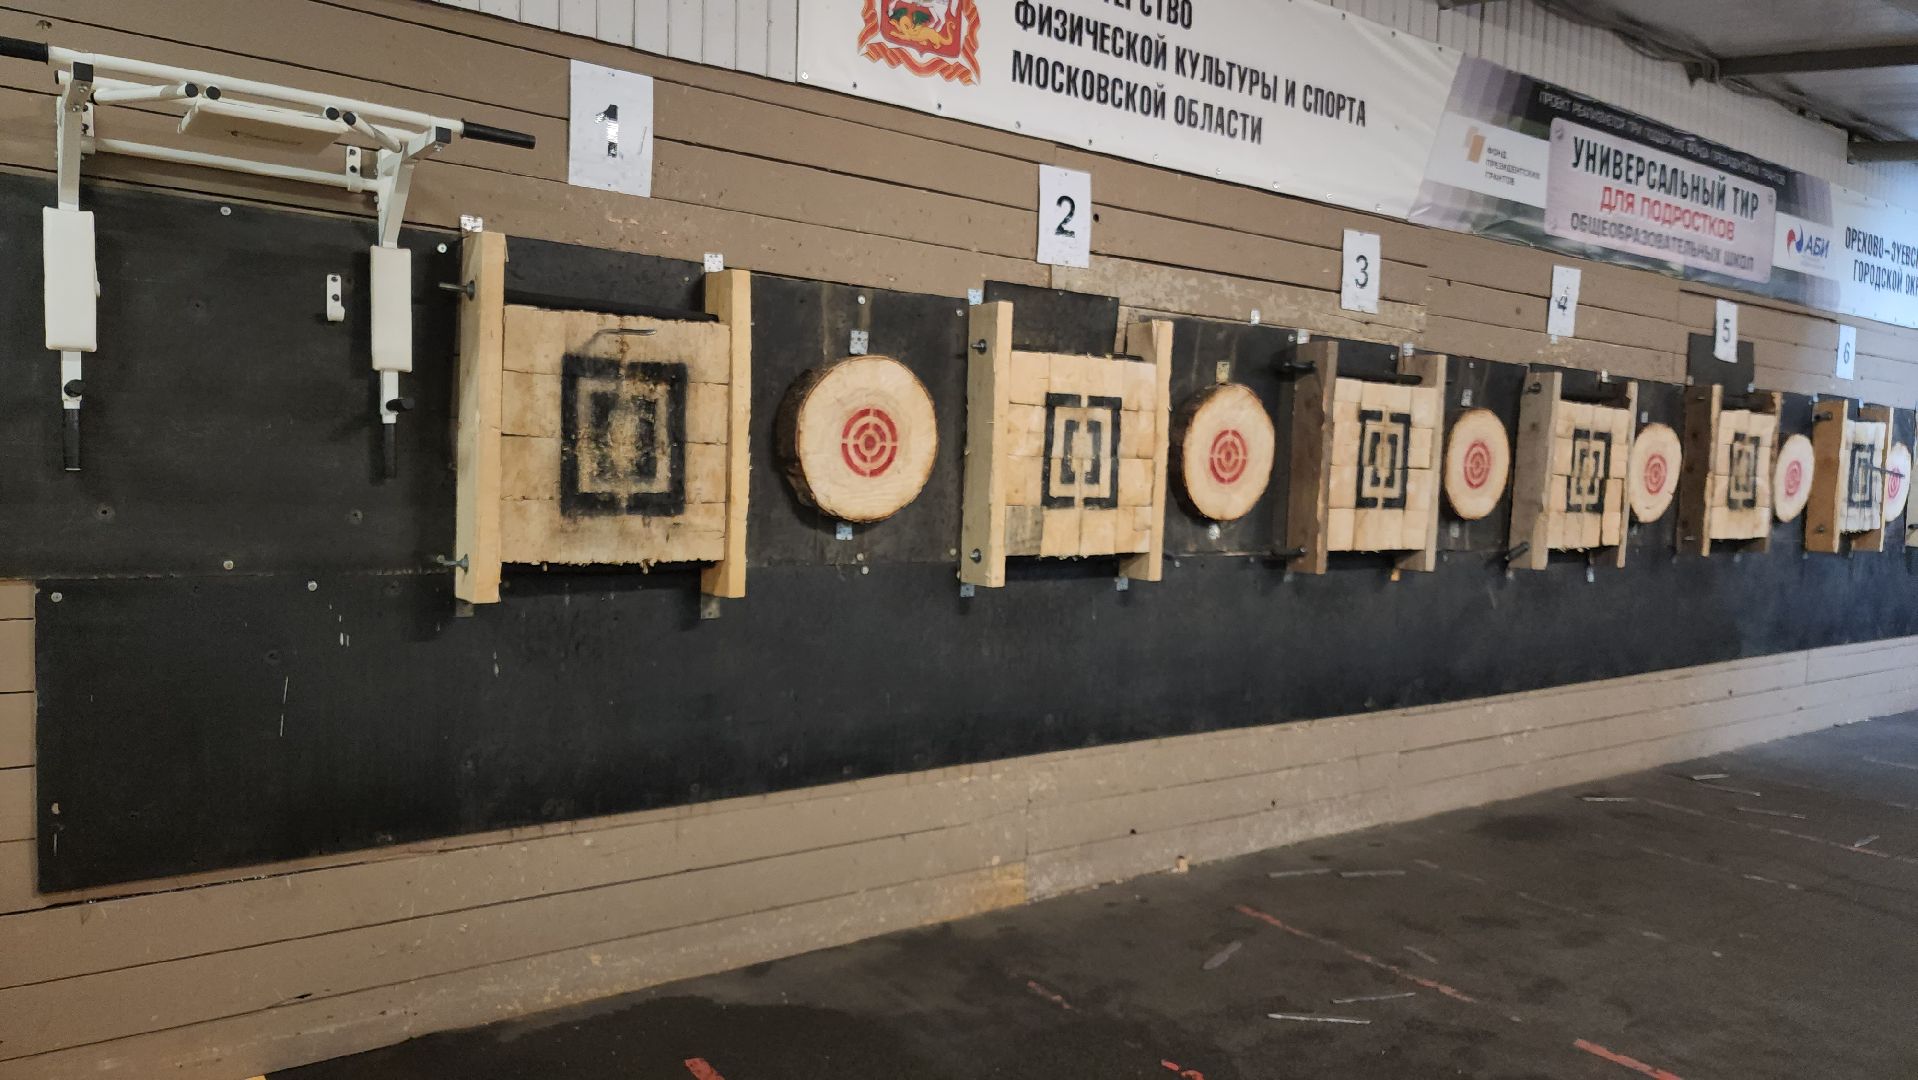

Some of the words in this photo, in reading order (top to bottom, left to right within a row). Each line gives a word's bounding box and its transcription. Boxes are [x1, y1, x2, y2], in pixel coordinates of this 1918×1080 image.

[1103, 0, 1193, 30] СТВО
[1014, 0, 1167, 71] ФИЗИЧЕСКОЙ
[1175, 46, 1278, 103] КУЛЬТУРЫ
[1284, 79, 1296, 108] И
[1302, 84, 1366, 127] СПОРТА
[1012, 50, 1166, 121] МОСКОВСКОЙ
[1174, 95, 1263, 145] ОБЛАСТИ
[594, 104, 618, 158] 1
[1487, 146, 1507, 160] ФОНД
[1572, 136, 1727, 211] УНИВЕРСАЛЬНЫЙ
[1733, 187, 1760, 220] ТИР
[1055, 195, 1076, 239] 2
[1600, 186, 1635, 214] ДЛЯ
[1641, 197, 1736, 241] ПОДРОСТКОВ
[1571, 212, 1721, 263] ОБЩЕОБРАЗОВАТЕЛЬНЫХ
[1724, 250, 1755, 272] ШКОЛ
[1804, 233, 1830, 258] АБИ
[1355, 254, 1369, 290] 3
[1853, 259, 1903, 293] ГОРОДСКОЙ
[1722, 318, 1731, 344] 5
[1843, 342, 1851, 365] 6
